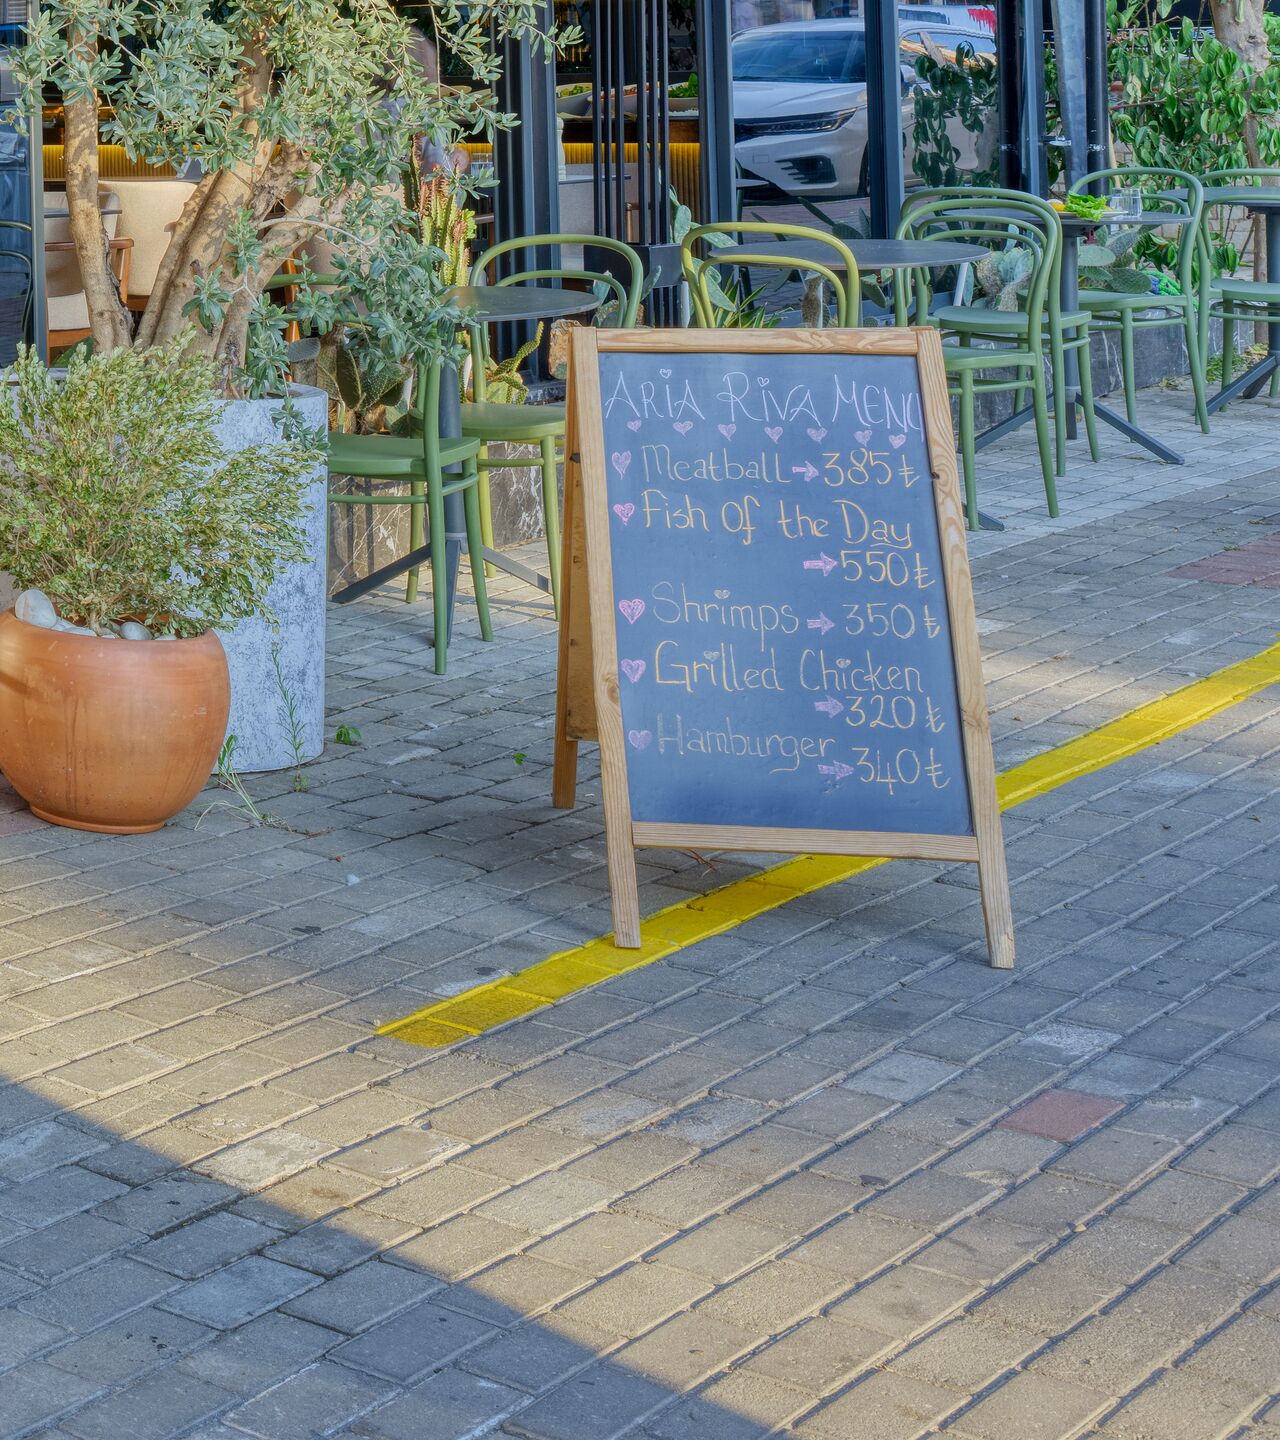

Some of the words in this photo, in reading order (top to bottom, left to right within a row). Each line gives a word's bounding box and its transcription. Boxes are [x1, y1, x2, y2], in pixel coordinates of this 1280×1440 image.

[832, 373, 925, 442] MENU
[640, 444, 793, 483] Meatball
[641, 489, 709, 532] Fish
[777, 499, 829, 539] the
[832, 499, 912, 549] Day
[651, 581, 799, 652] Shrimps
[655, 640, 785, 693] Grilled
[800, 648, 924, 693] Chicken
[657, 713, 836, 775] Hamburger
